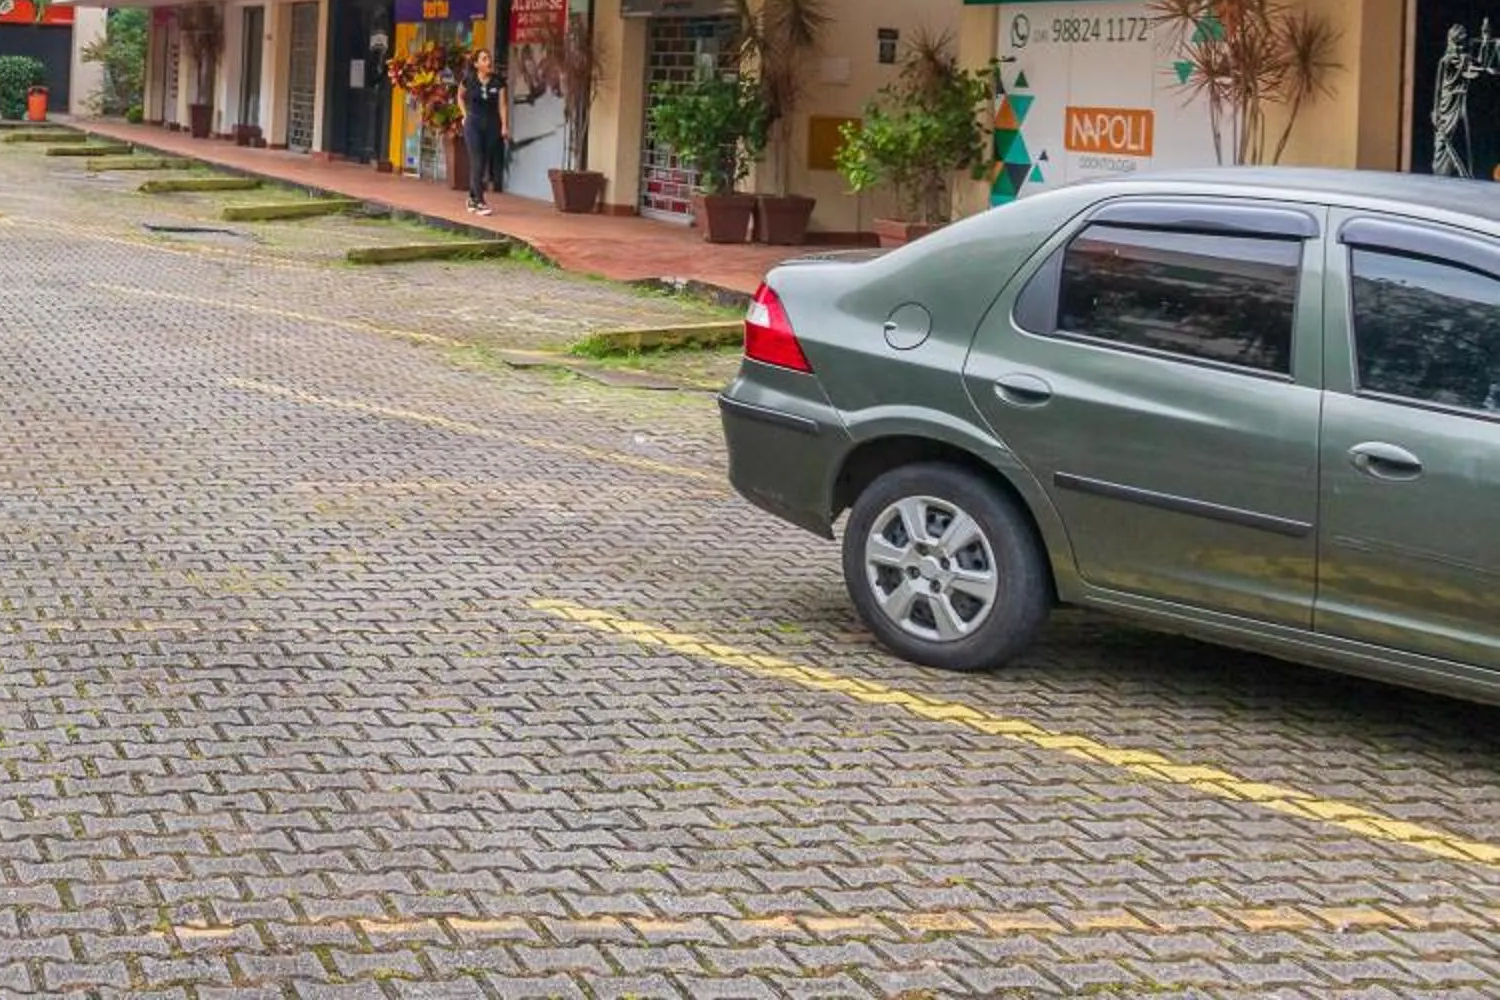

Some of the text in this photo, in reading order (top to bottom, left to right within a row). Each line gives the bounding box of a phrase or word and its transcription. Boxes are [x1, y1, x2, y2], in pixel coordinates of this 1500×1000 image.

[1051, 17, 1101, 43] 98824
[1106, 16, 1148, 42] 1172
[1071, 112, 1146, 151] NAPOLI
